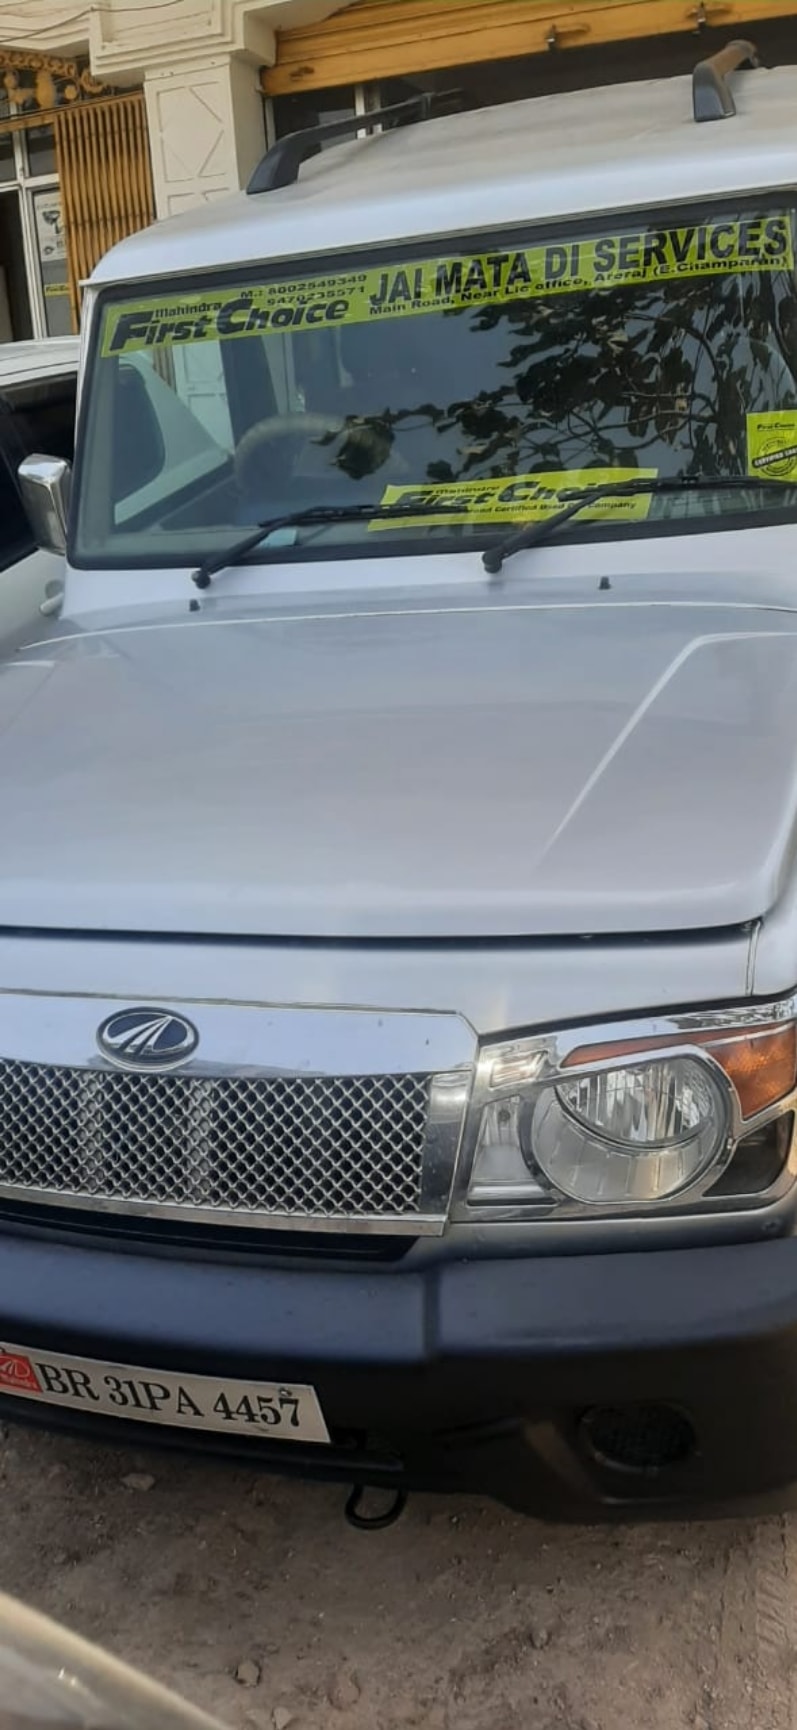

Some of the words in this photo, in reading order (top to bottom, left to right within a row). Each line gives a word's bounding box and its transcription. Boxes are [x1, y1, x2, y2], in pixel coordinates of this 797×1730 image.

[369, 268, 422, 305] JAI
[435, 252, 532, 296] MATA
[545, 245, 580, 281] DI
[593, 219, 787, 272] SERVICES
[110, 310, 212, 351] First
[216, 296, 349, 335] Choice
[369, 302, 406, 315] Main
[411, 297, 455, 310] Road,
[461, 289, 499, 301] Near
[35, 1363, 99, 1401] BR
[213, 1392, 300, 1427] 4457
